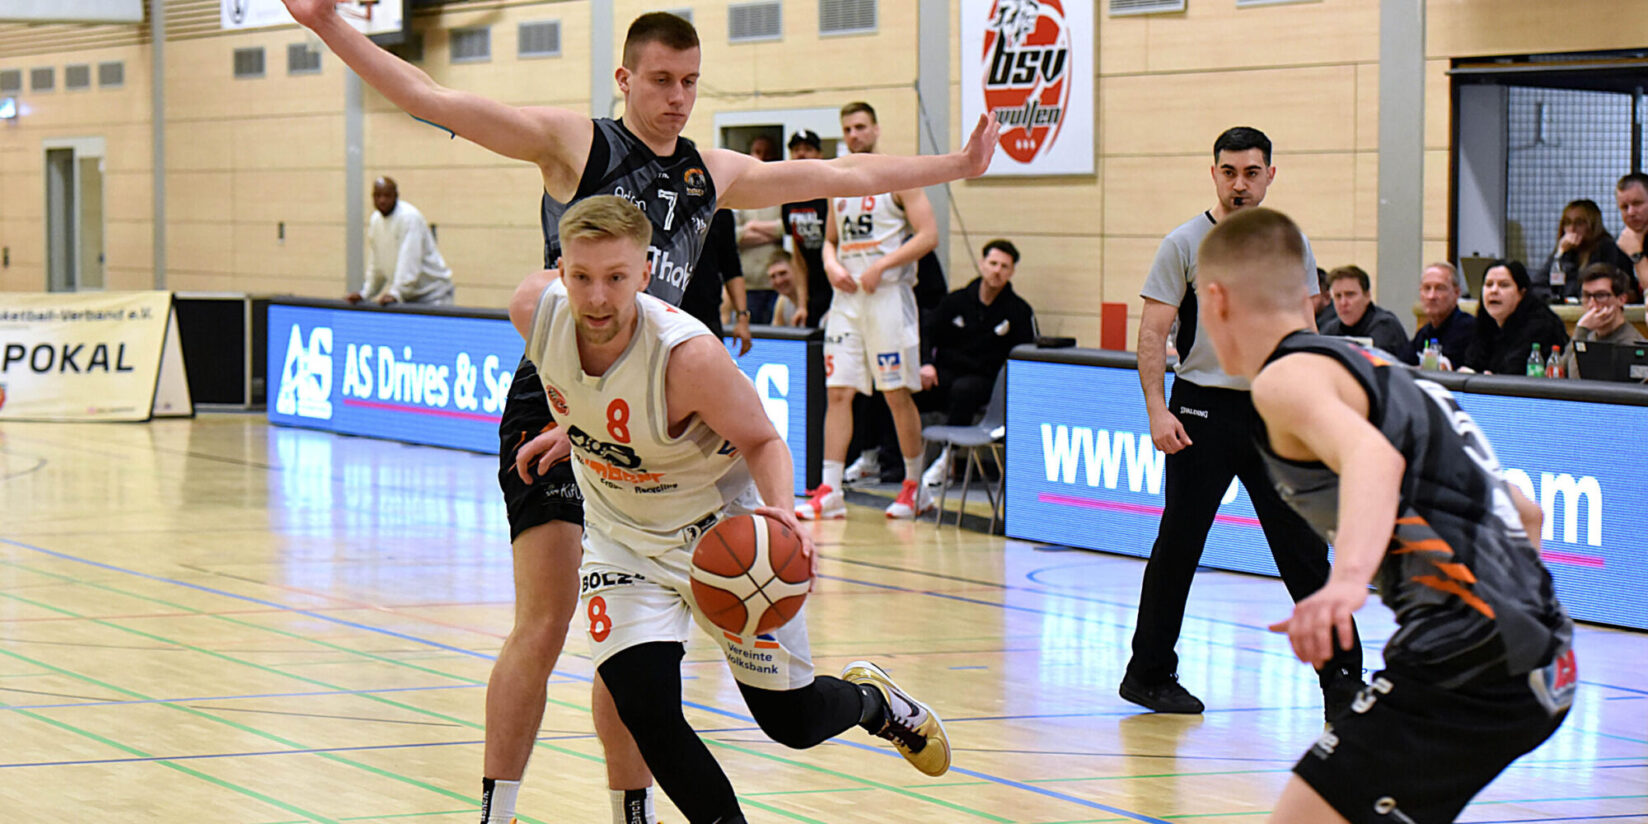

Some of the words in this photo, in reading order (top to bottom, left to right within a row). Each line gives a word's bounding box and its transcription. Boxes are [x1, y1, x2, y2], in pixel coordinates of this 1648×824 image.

[987, 28, 1068, 85] bsv
[658, 188, 678, 231] 7
[3, 343, 134, 374] POKAL
[341, 343, 374, 400] AS
[377, 345, 450, 408] Drives
[453, 352, 478, 412] &
[606, 398, 631, 444] 8
[588, 595, 612, 643] 8
[728, 641, 773, 662] Vereinte
